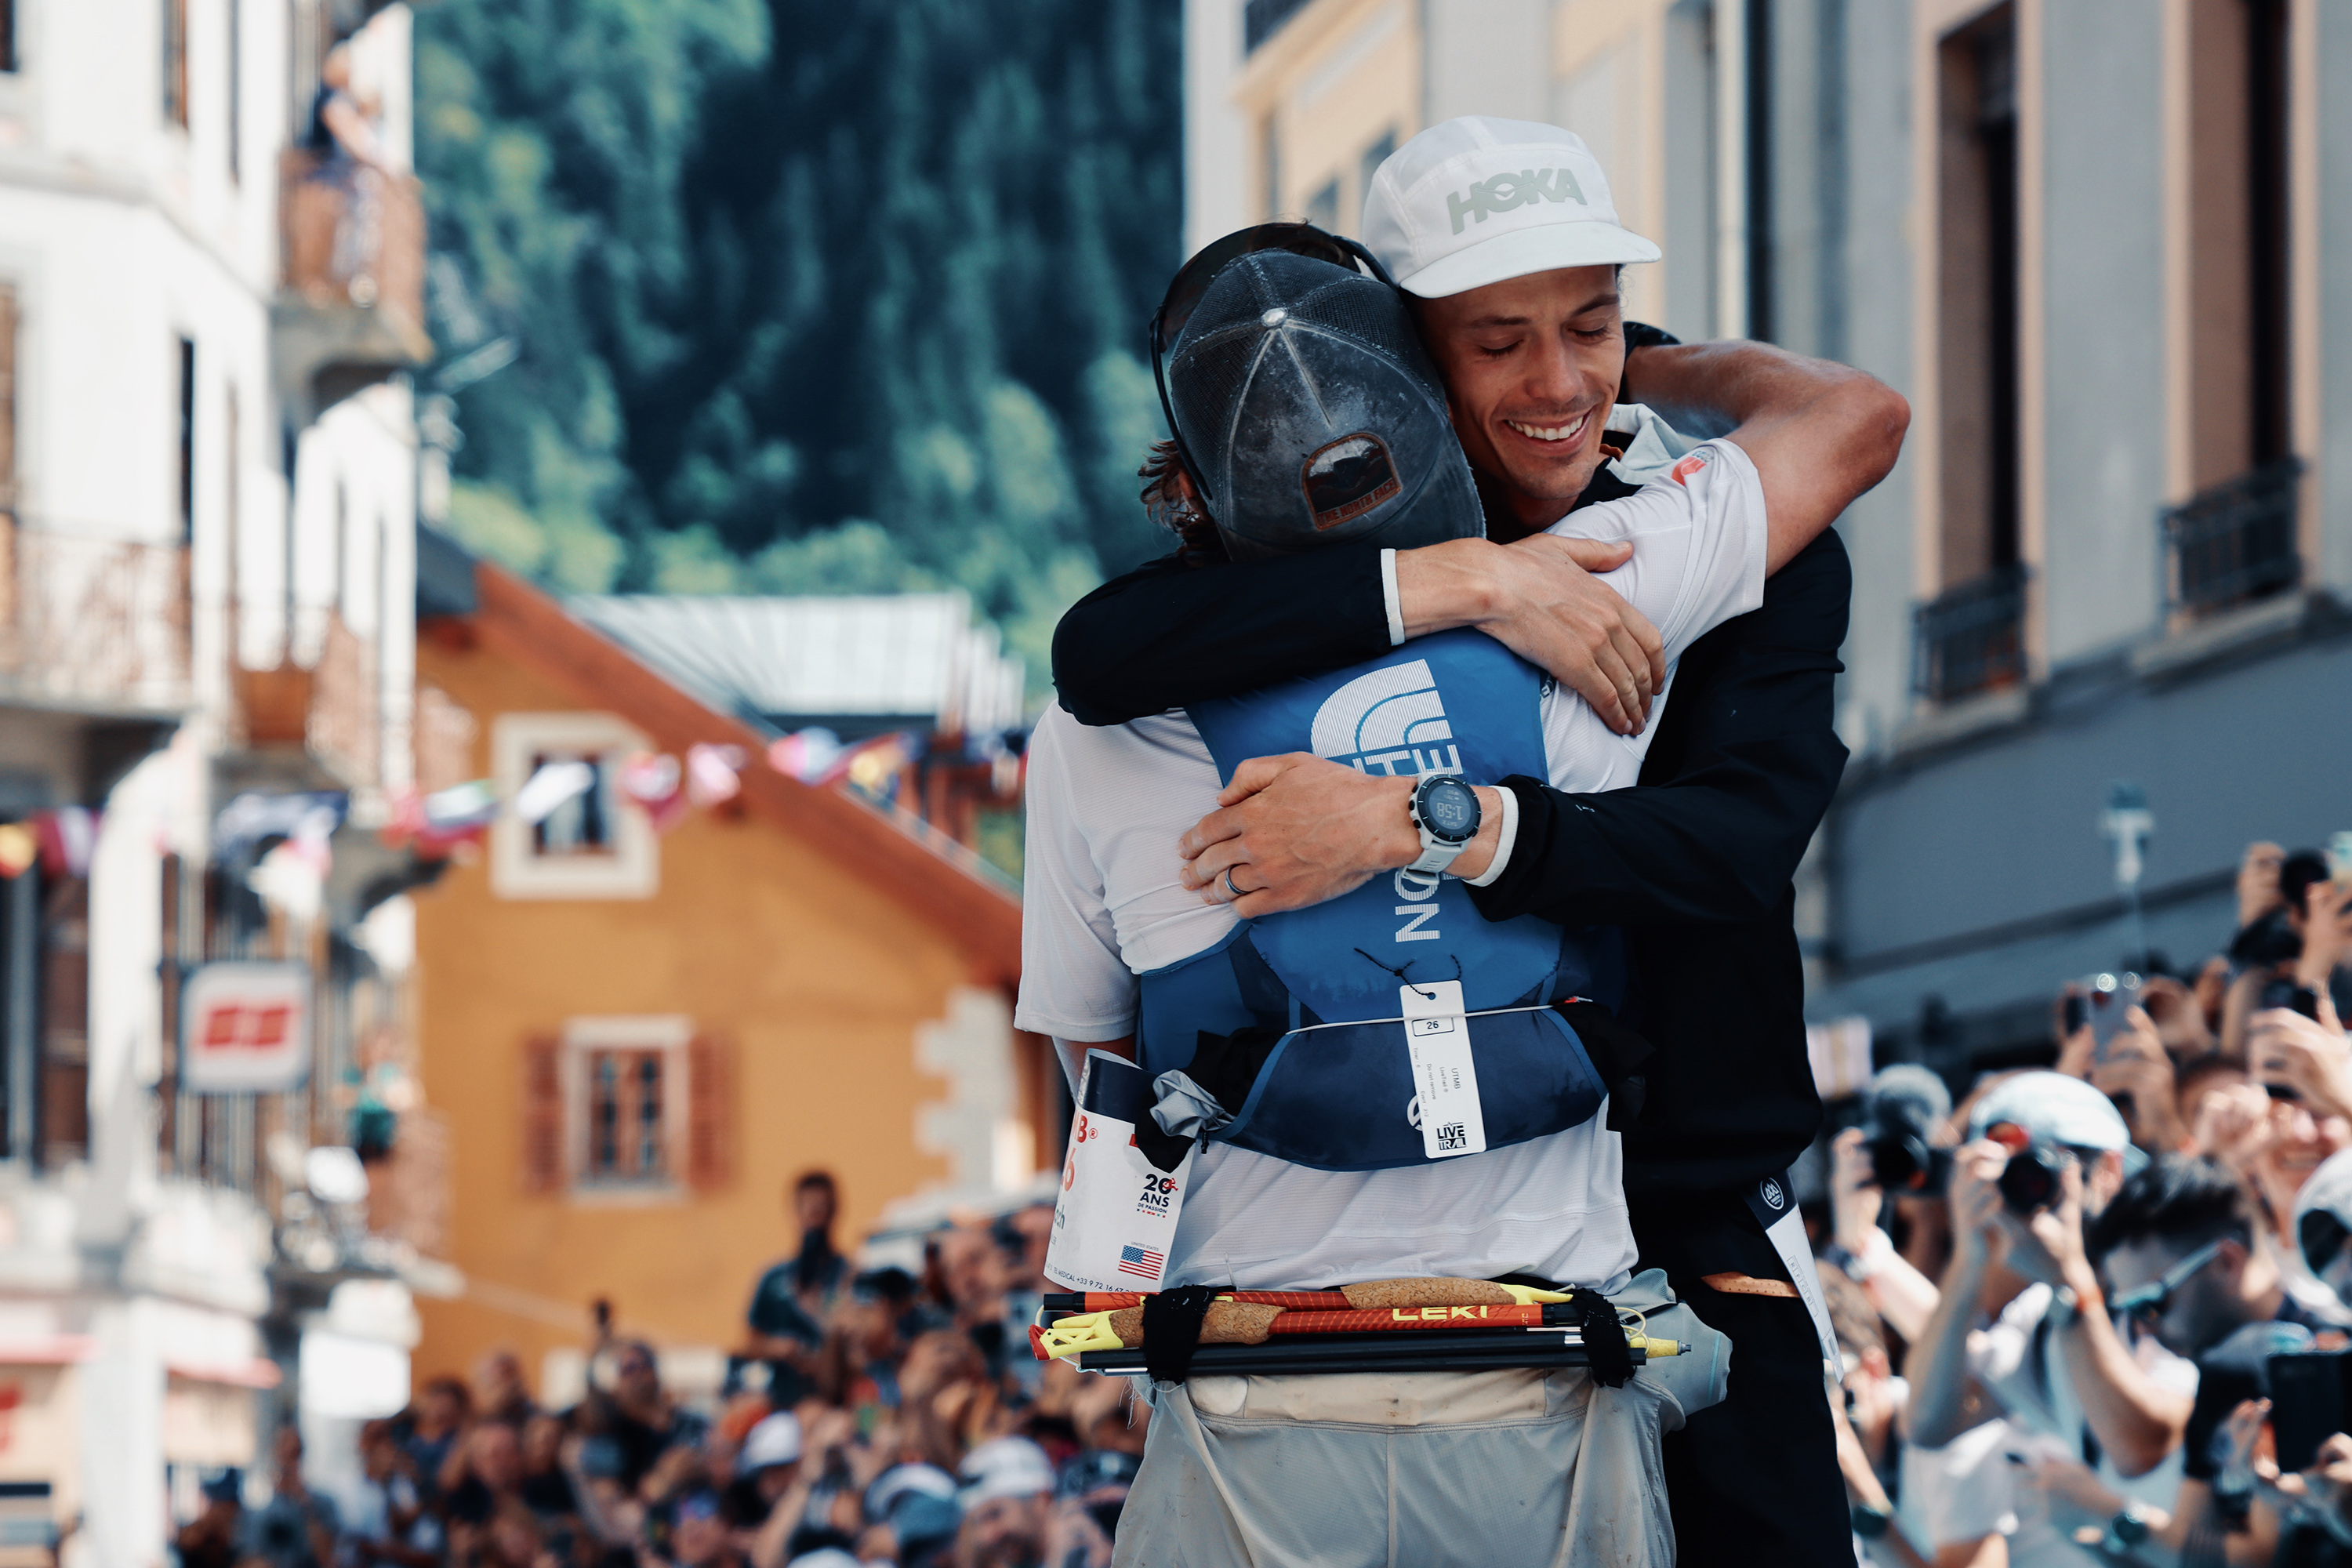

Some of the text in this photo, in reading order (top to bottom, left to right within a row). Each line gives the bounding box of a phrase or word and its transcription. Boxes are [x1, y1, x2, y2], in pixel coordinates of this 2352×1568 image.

[1446, 168, 1588, 235] HOKA
[1339, 494, 1374, 517] NORTH
[1373, 478, 1396, 500] FACE
[1436, 802, 1464, 821] 1:58
[1426, 1021, 1439, 1029] 26
[1451, 1068, 1461, 1090] UTMB
[1436, 1125, 1465, 1139] LIVE
[1439, 1138, 1467, 1150] TRAIL
[1143, 1174, 1172, 1195] 20
[1139, 1192, 1170, 1207] ANS
[1145, 1204, 1167, 1214] PASSION
[1058, 1269, 1075, 1282] MEDICAL
[1392, 1305, 1488, 1321] LEKI
